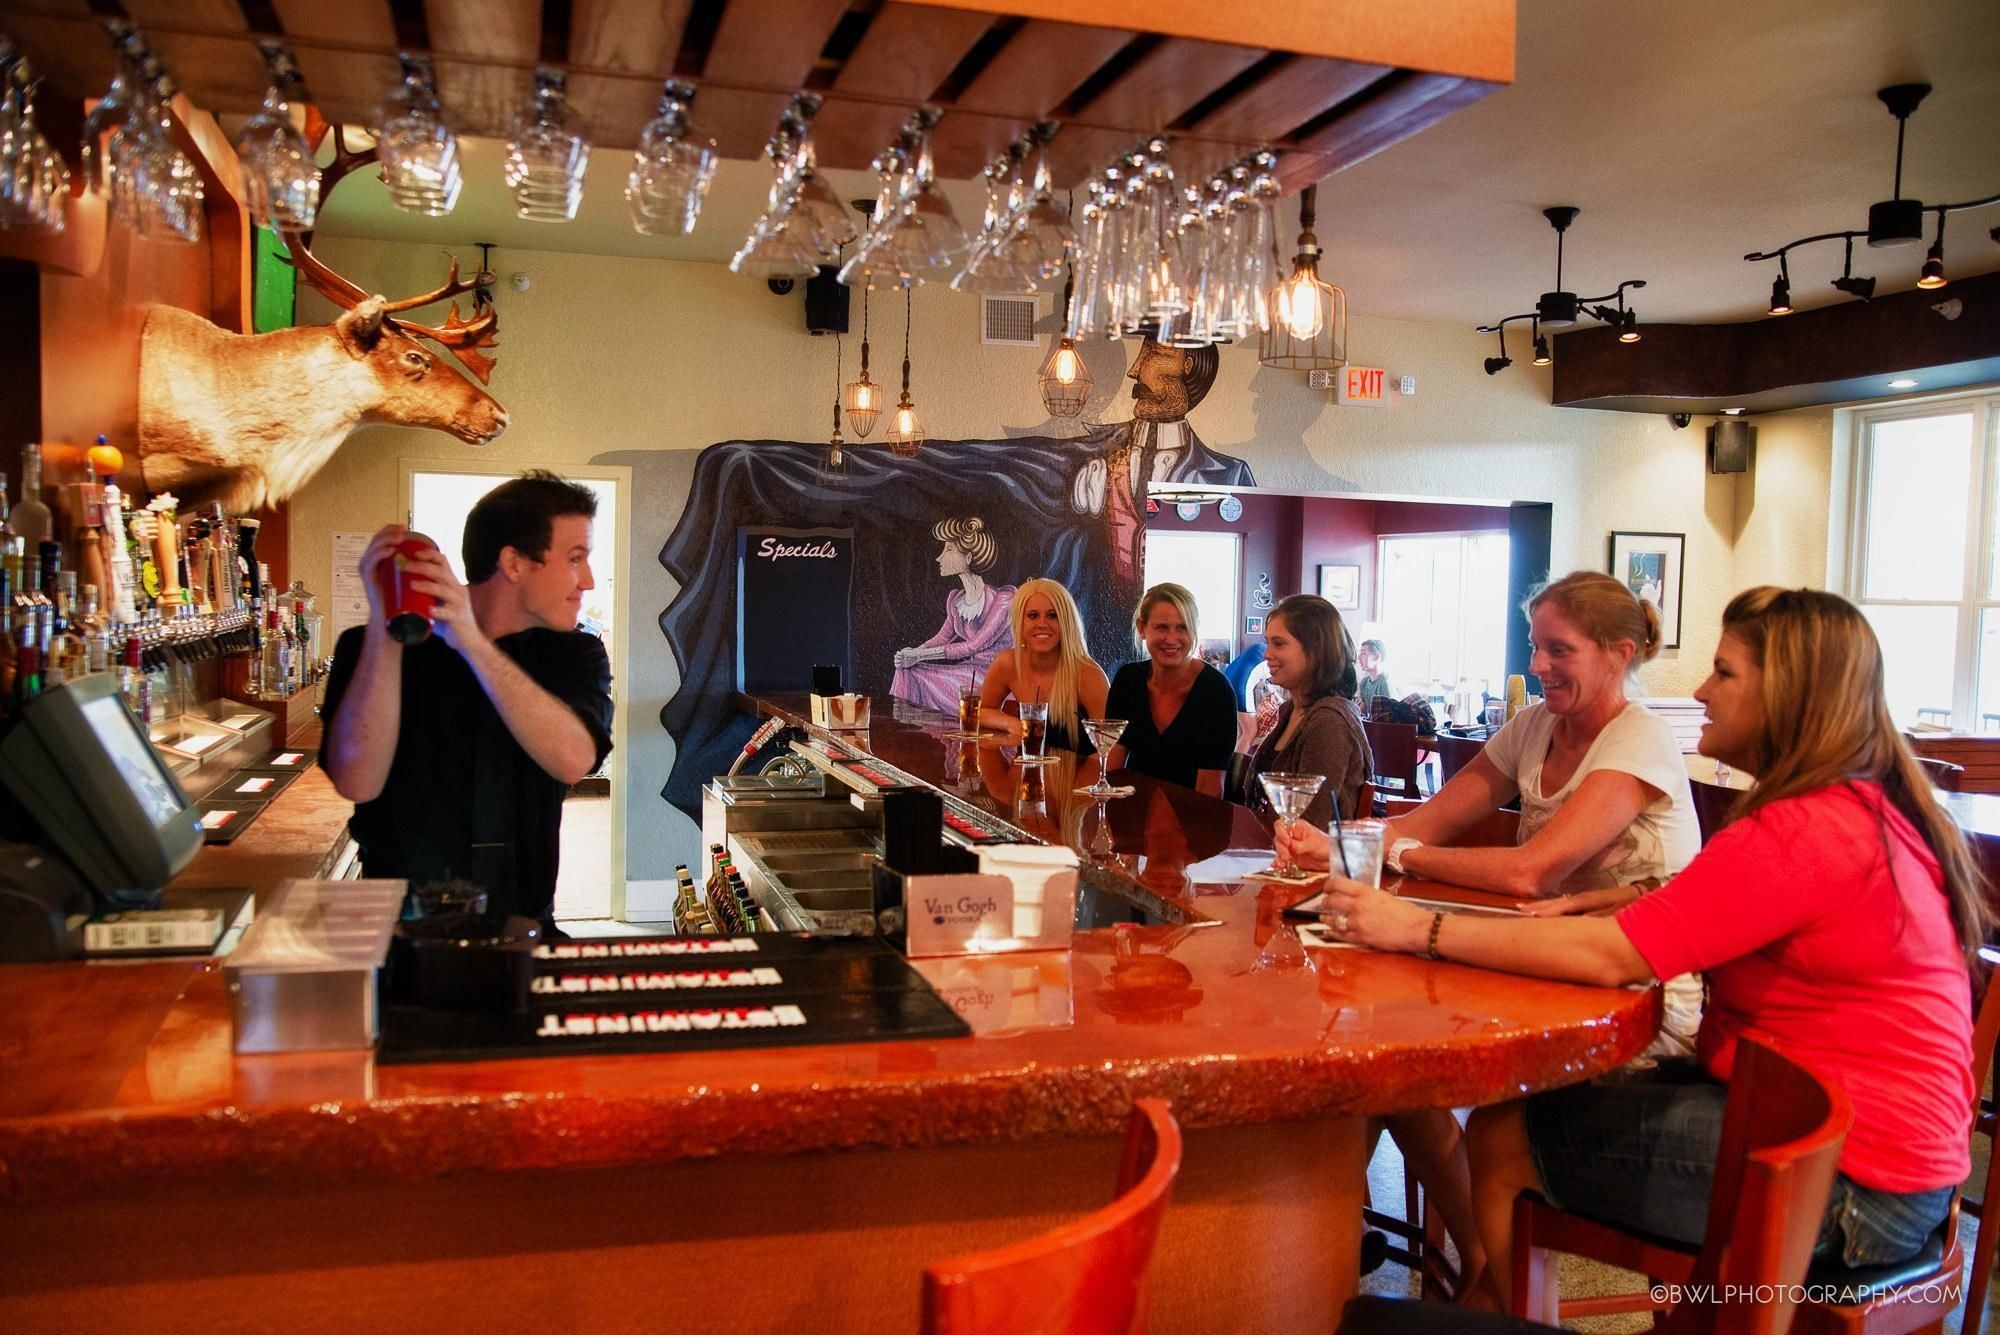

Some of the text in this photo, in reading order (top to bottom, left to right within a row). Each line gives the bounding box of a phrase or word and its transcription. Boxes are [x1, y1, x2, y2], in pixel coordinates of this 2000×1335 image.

[1347, 367, 1384, 400] EXIT
[757, 537, 838, 562] Specials
[924, 896, 997, 916] Van Gogh
